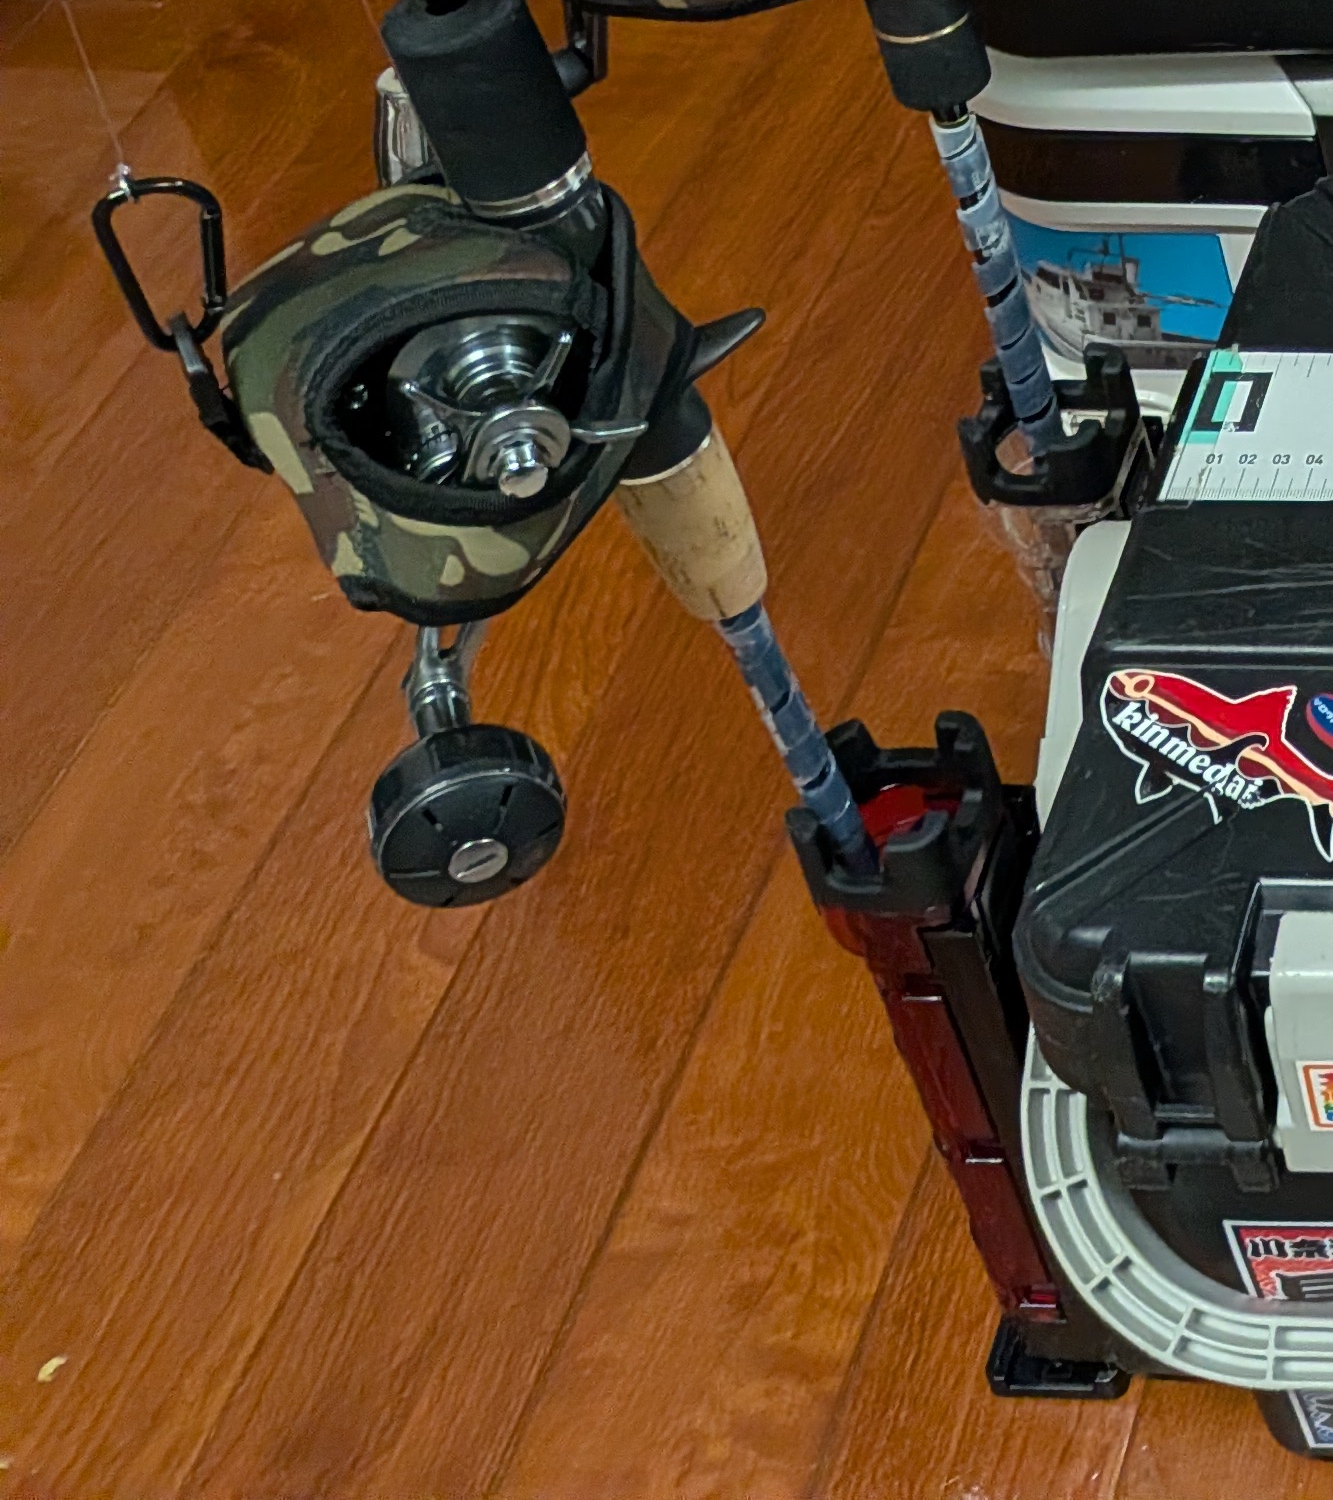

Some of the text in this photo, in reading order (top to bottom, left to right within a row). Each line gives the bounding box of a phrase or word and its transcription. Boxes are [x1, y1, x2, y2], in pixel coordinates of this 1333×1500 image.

[1191, 371, 1275, 433] 0
[1205, 453, 1224, 465] 01
[1238, 453, 1258, 465] 02
[1272, 453, 1291, 465] 03
[1305, 454, 1324, 466] 04
